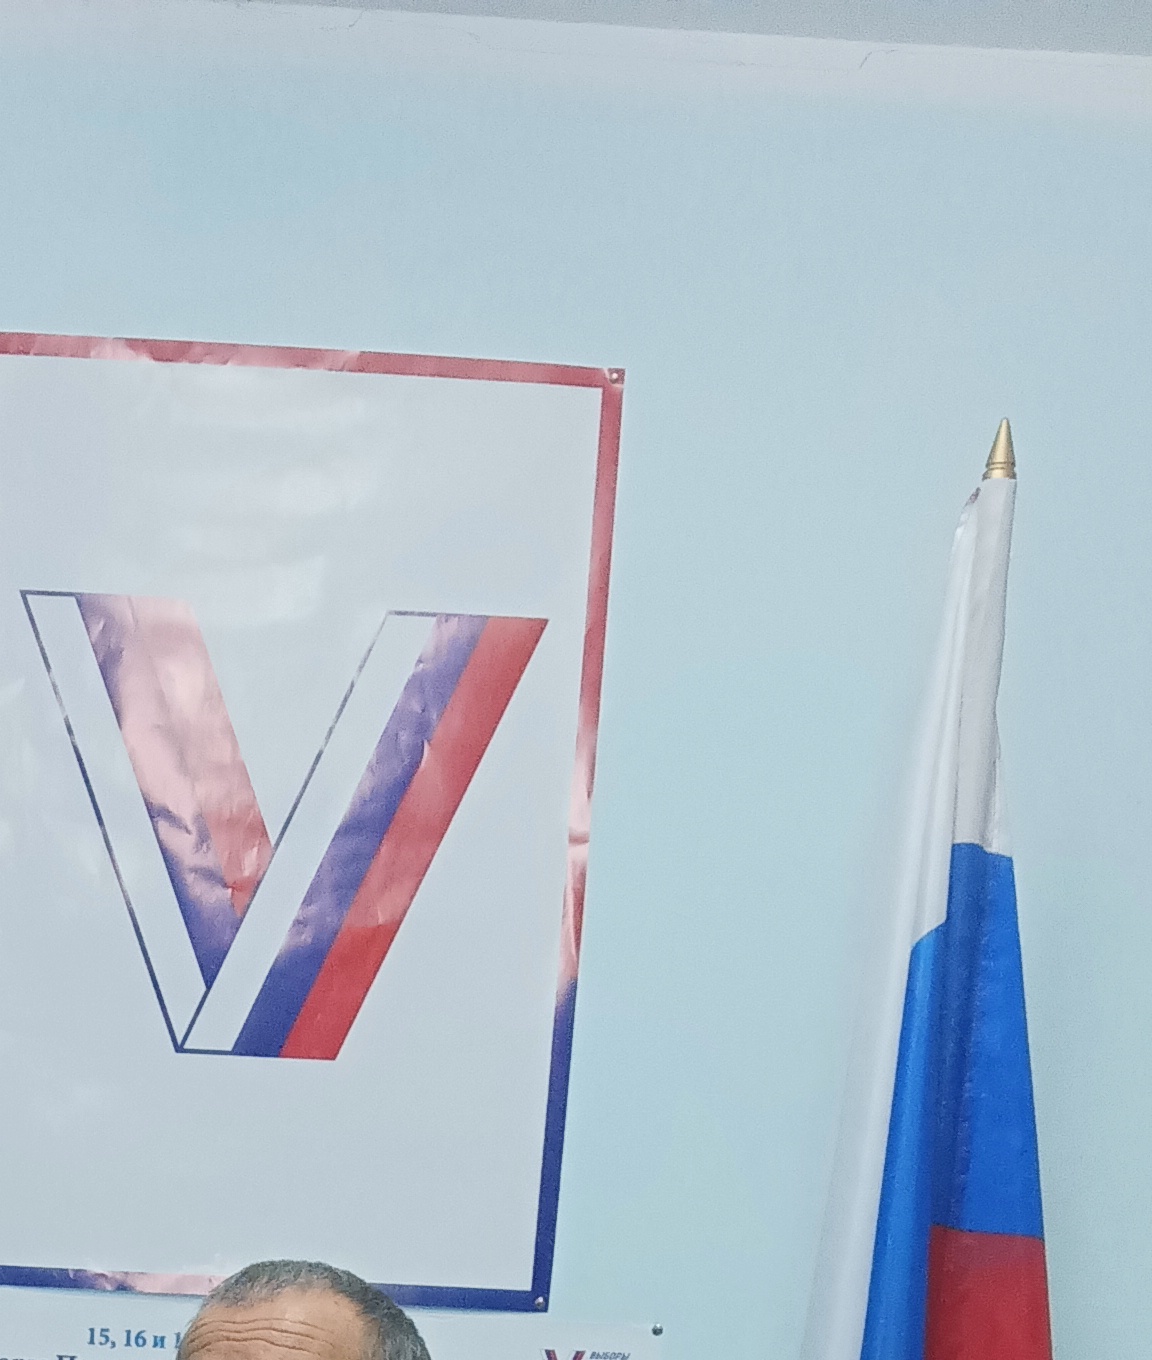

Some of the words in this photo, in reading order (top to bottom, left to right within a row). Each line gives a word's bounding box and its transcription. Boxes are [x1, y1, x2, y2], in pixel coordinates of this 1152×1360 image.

[87, 1327, 116, 1349] 15,
[123, 1329, 147, 1348] 16
[152, 1335, 166, 1349] и
[589, 1351, 631, 1360] ВЫБОРЫ
